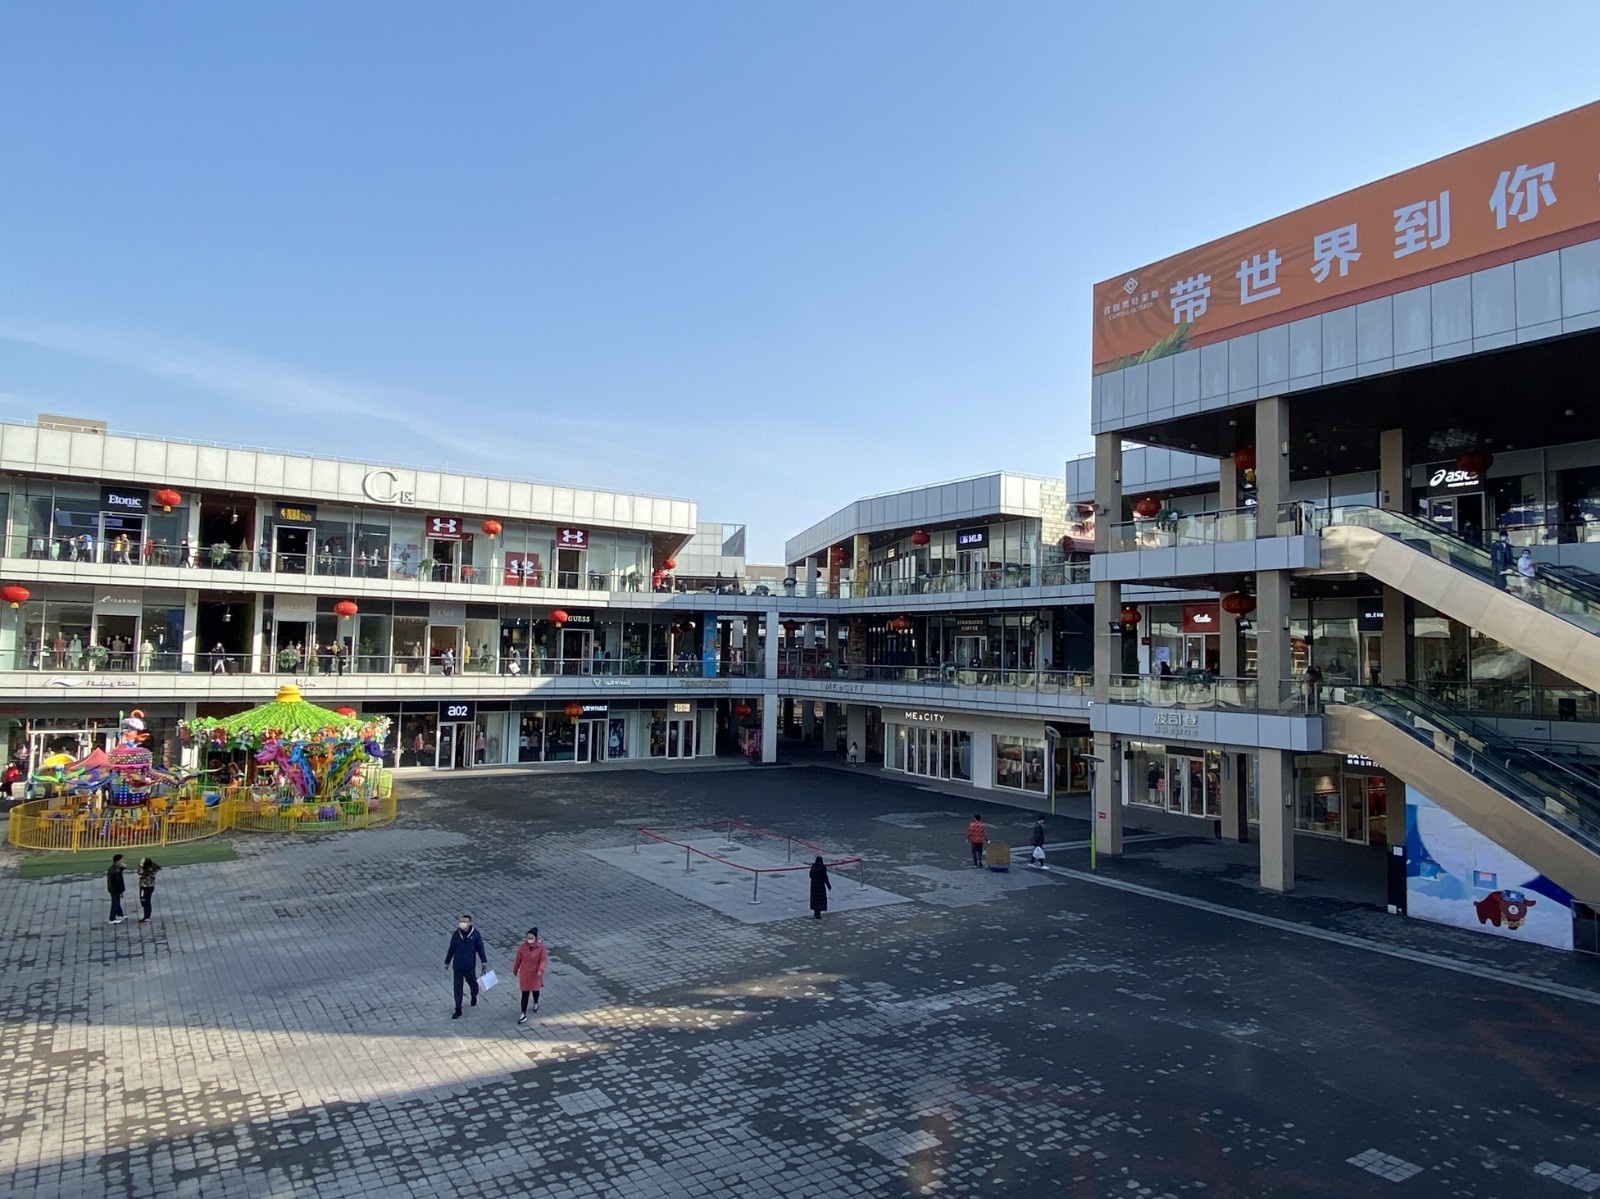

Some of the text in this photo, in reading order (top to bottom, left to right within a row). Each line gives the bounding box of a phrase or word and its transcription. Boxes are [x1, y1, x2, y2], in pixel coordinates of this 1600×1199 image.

[108, 494, 142, 506] Etonic
[968, 533, 983, 543] MLB
[447, 705, 468, 717] a02
[1155, 712, 1198, 728] 波司登
